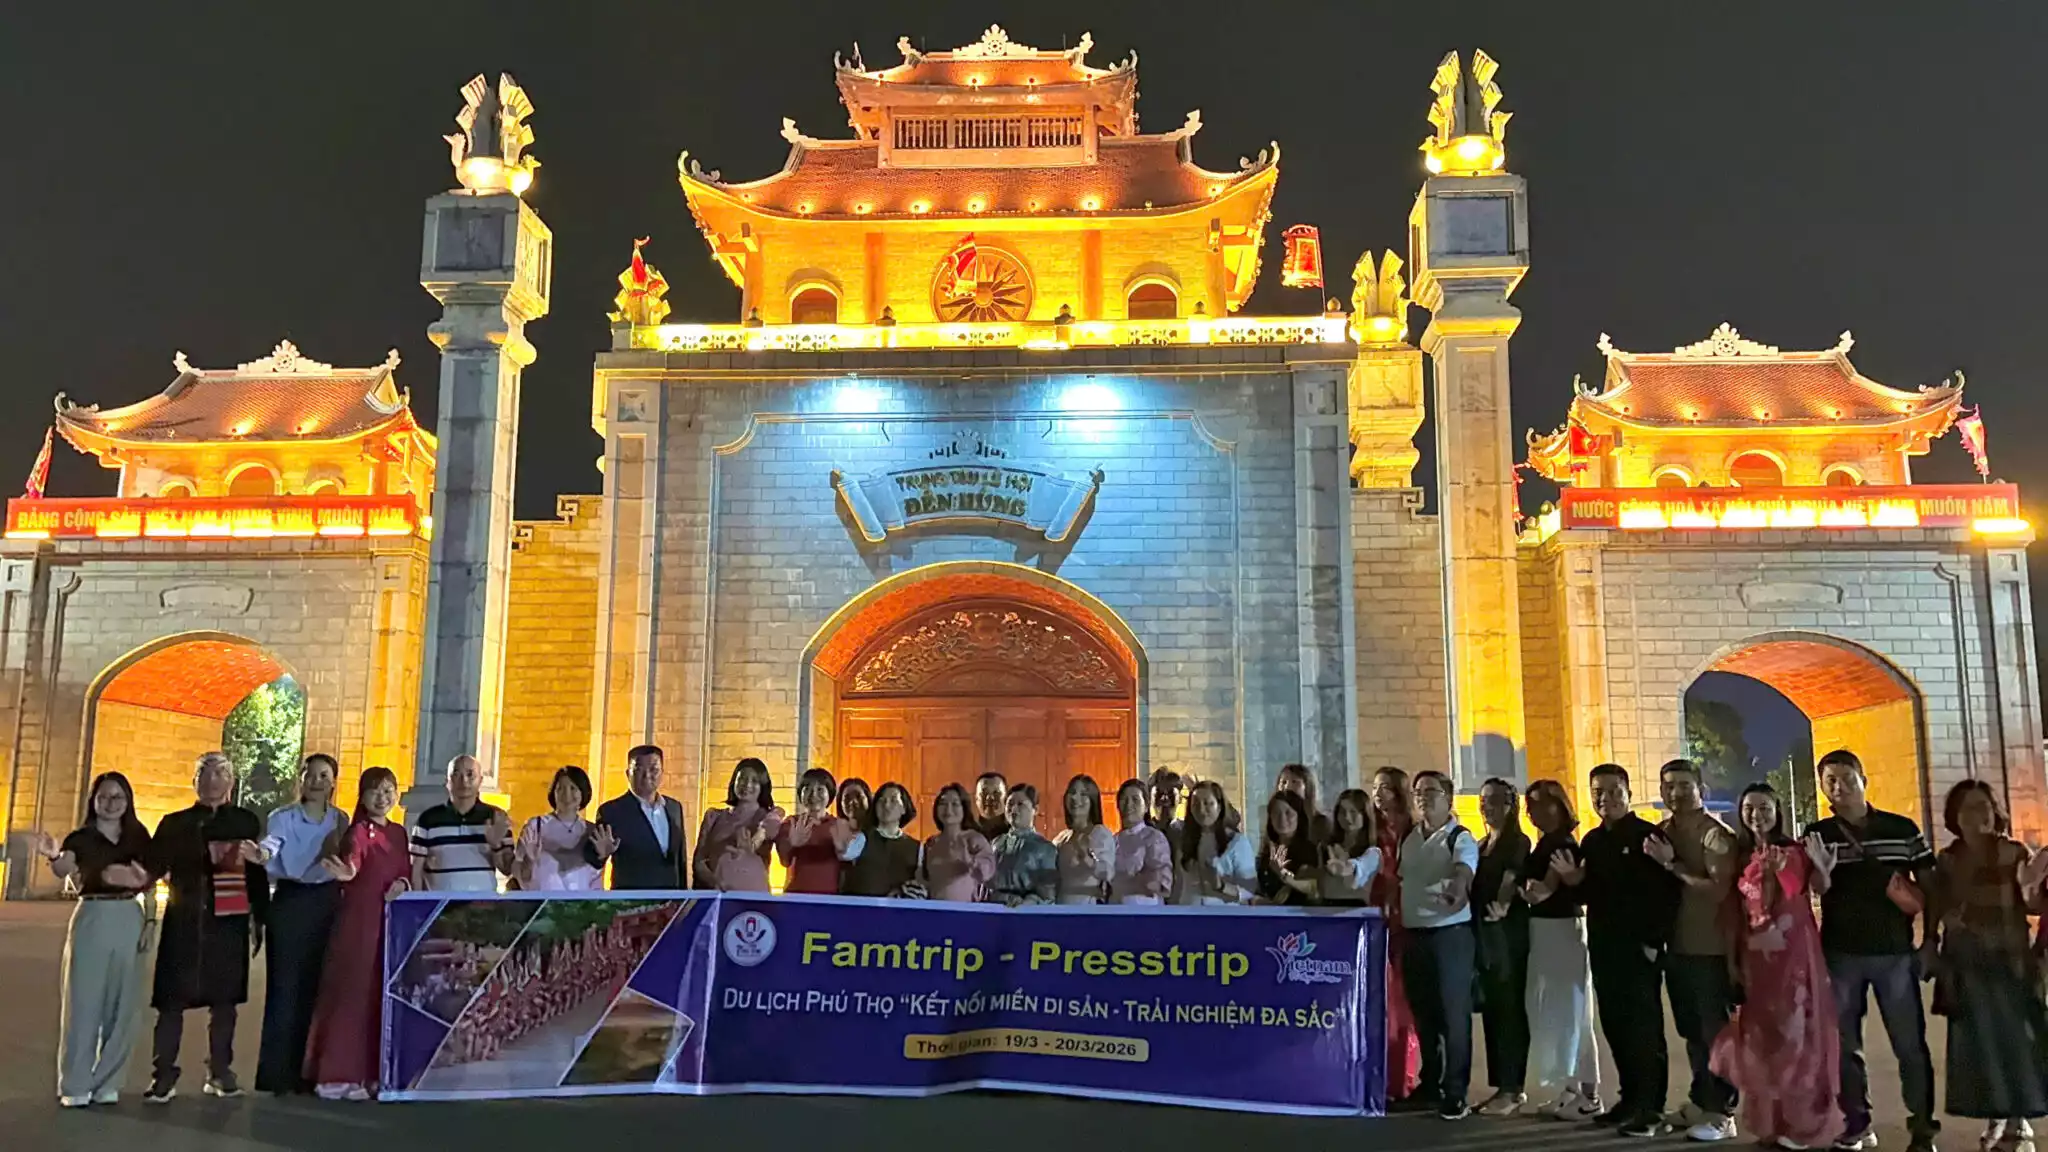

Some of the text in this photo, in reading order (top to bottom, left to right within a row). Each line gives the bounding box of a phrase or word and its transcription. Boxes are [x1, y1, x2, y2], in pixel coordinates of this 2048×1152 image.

[64, 508, 106, 532] CỘNG
[318, 503, 364, 525] MUÔN
[1572, 498, 1615, 518] NƯỚC
[1920, 495, 1967, 516] MUÔN
[801, 931, 984, 980] Famtrip
[1030, 940, 1249, 985] Presstrip
[723, 988, 752, 1009] DU
[756, 991, 801, 1015] LỊCH
[805, 989, 848, 1013] PHÚ
[854, 992, 894, 1019] THỌ
[954, 989, 986, 1016] NỐI
[990, 986, 1038, 1012] MIỀN
[1044, 997, 1063, 1015] DI
[1068, 993, 1109, 1019] SẢN
[1123, 996, 1170, 1022] TRẢI
[1175, 999, 1255, 1029] NGHIỆM
[1261, 1006, 1290, 1027] ĐA
[1005, 1034, 1038, 1049] 19/3
[1055, 1037, 1137, 1056] 20/3/2026
